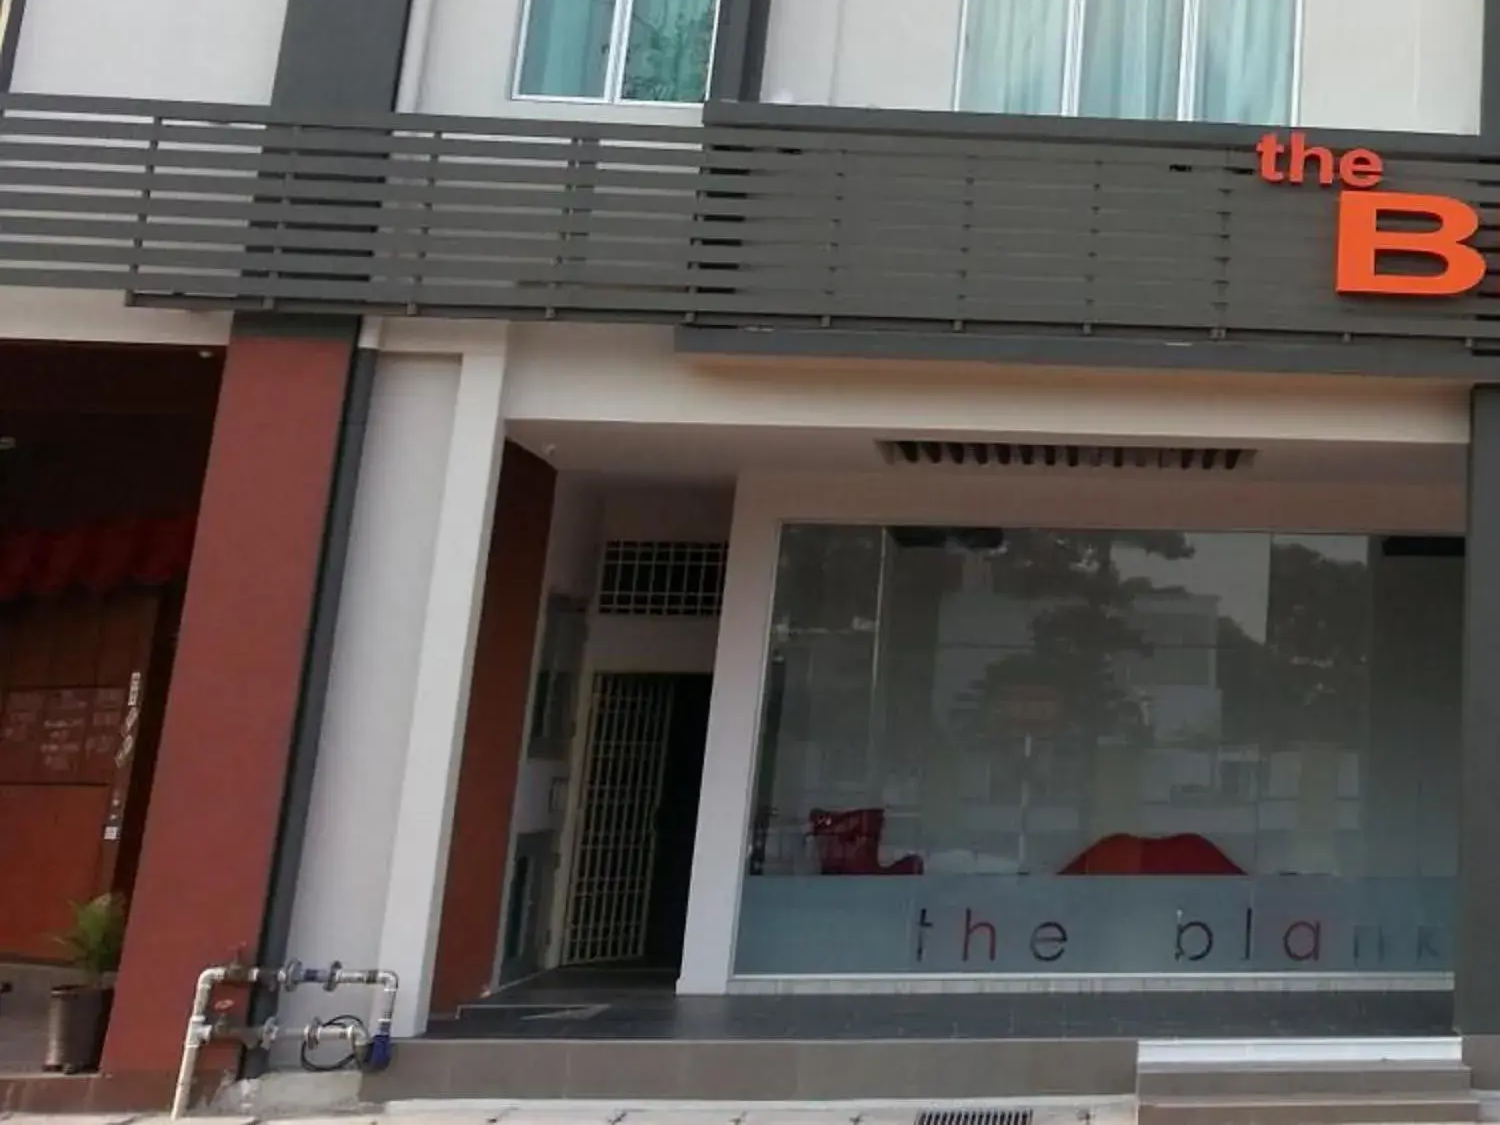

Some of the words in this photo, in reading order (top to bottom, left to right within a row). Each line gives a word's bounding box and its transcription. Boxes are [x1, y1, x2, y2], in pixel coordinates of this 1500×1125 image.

[1256, 132, 1383, 188] the
[915, 906, 1068, 963] the
[1175, 906, 1444, 963] blank
